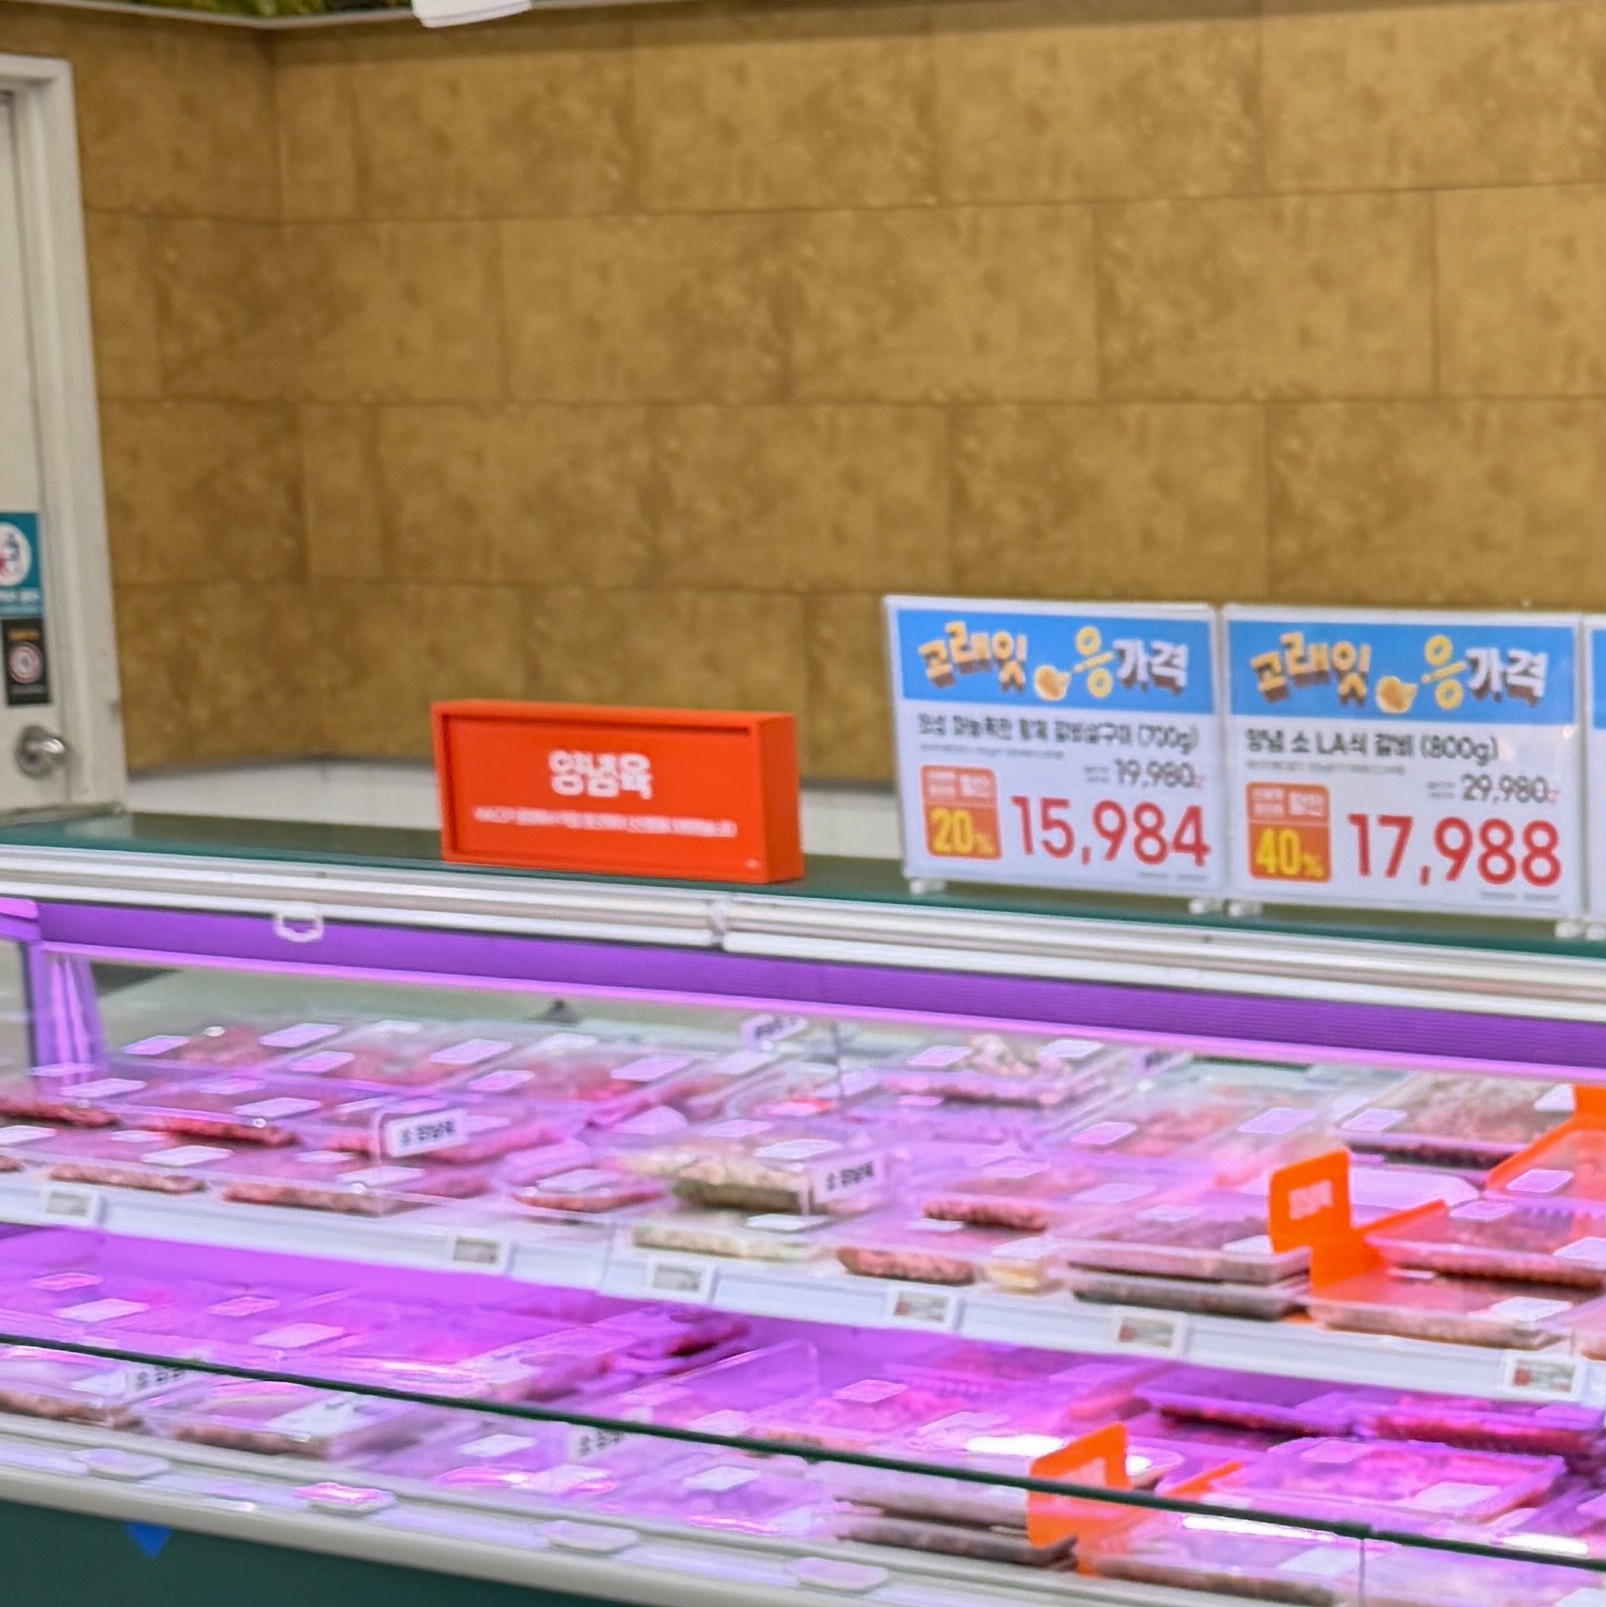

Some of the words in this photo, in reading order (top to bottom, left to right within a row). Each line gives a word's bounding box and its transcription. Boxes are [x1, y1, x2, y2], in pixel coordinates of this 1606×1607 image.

[917, 620, 1028, 693] 고래잇
[1250, 631, 1372, 706] 고래잇
[547, 748, 654, 801] 양념육
[1290, 730, 1311, 754] 소
[1420, 734, 1500, 767] (800g)
[930, 806, 996, 856] 20%
[1010, 795, 1212, 868] 15,984
[1255, 826, 1325, 879] 40%
[1347, 812, 1562, 887] 17,988
